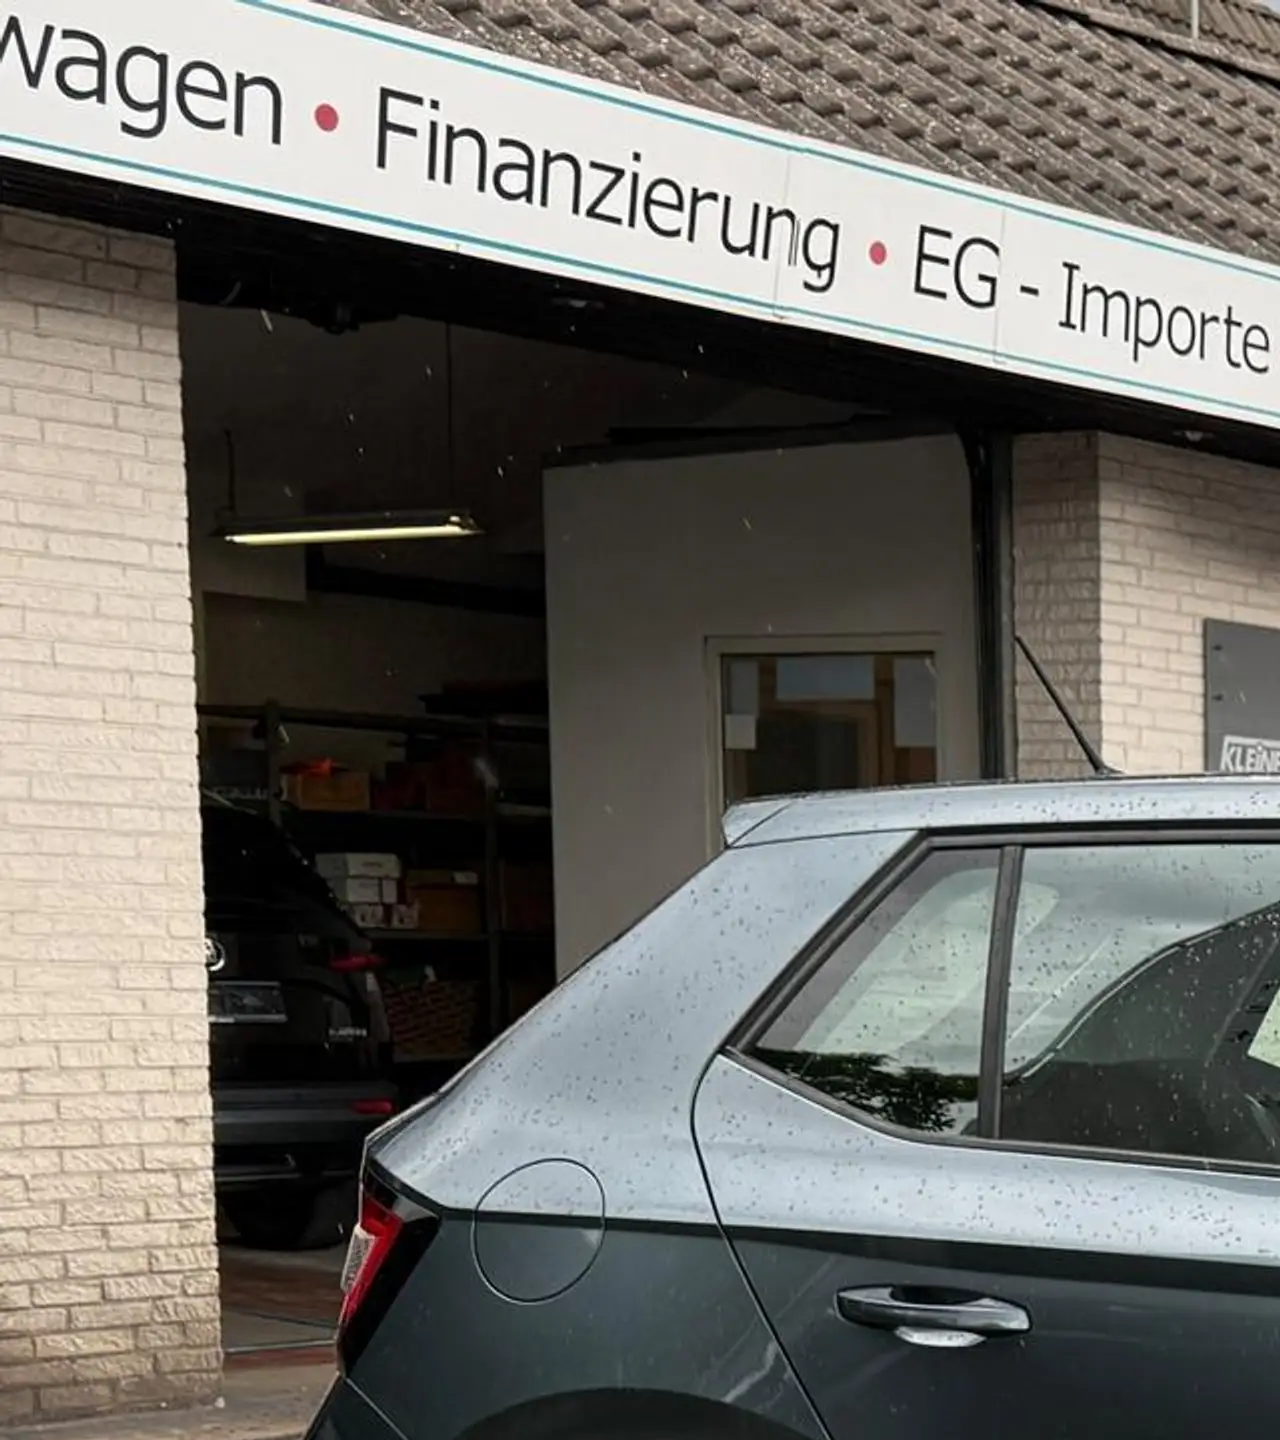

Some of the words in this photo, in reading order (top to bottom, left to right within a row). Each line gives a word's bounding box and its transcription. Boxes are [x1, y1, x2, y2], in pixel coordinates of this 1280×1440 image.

[0, 14, 283, 146] wagen
[376, 85, 842, 294] Finanzierung
[913, 223, 1002, 310] EG
[1057, 260, 1271, 375] Importe
